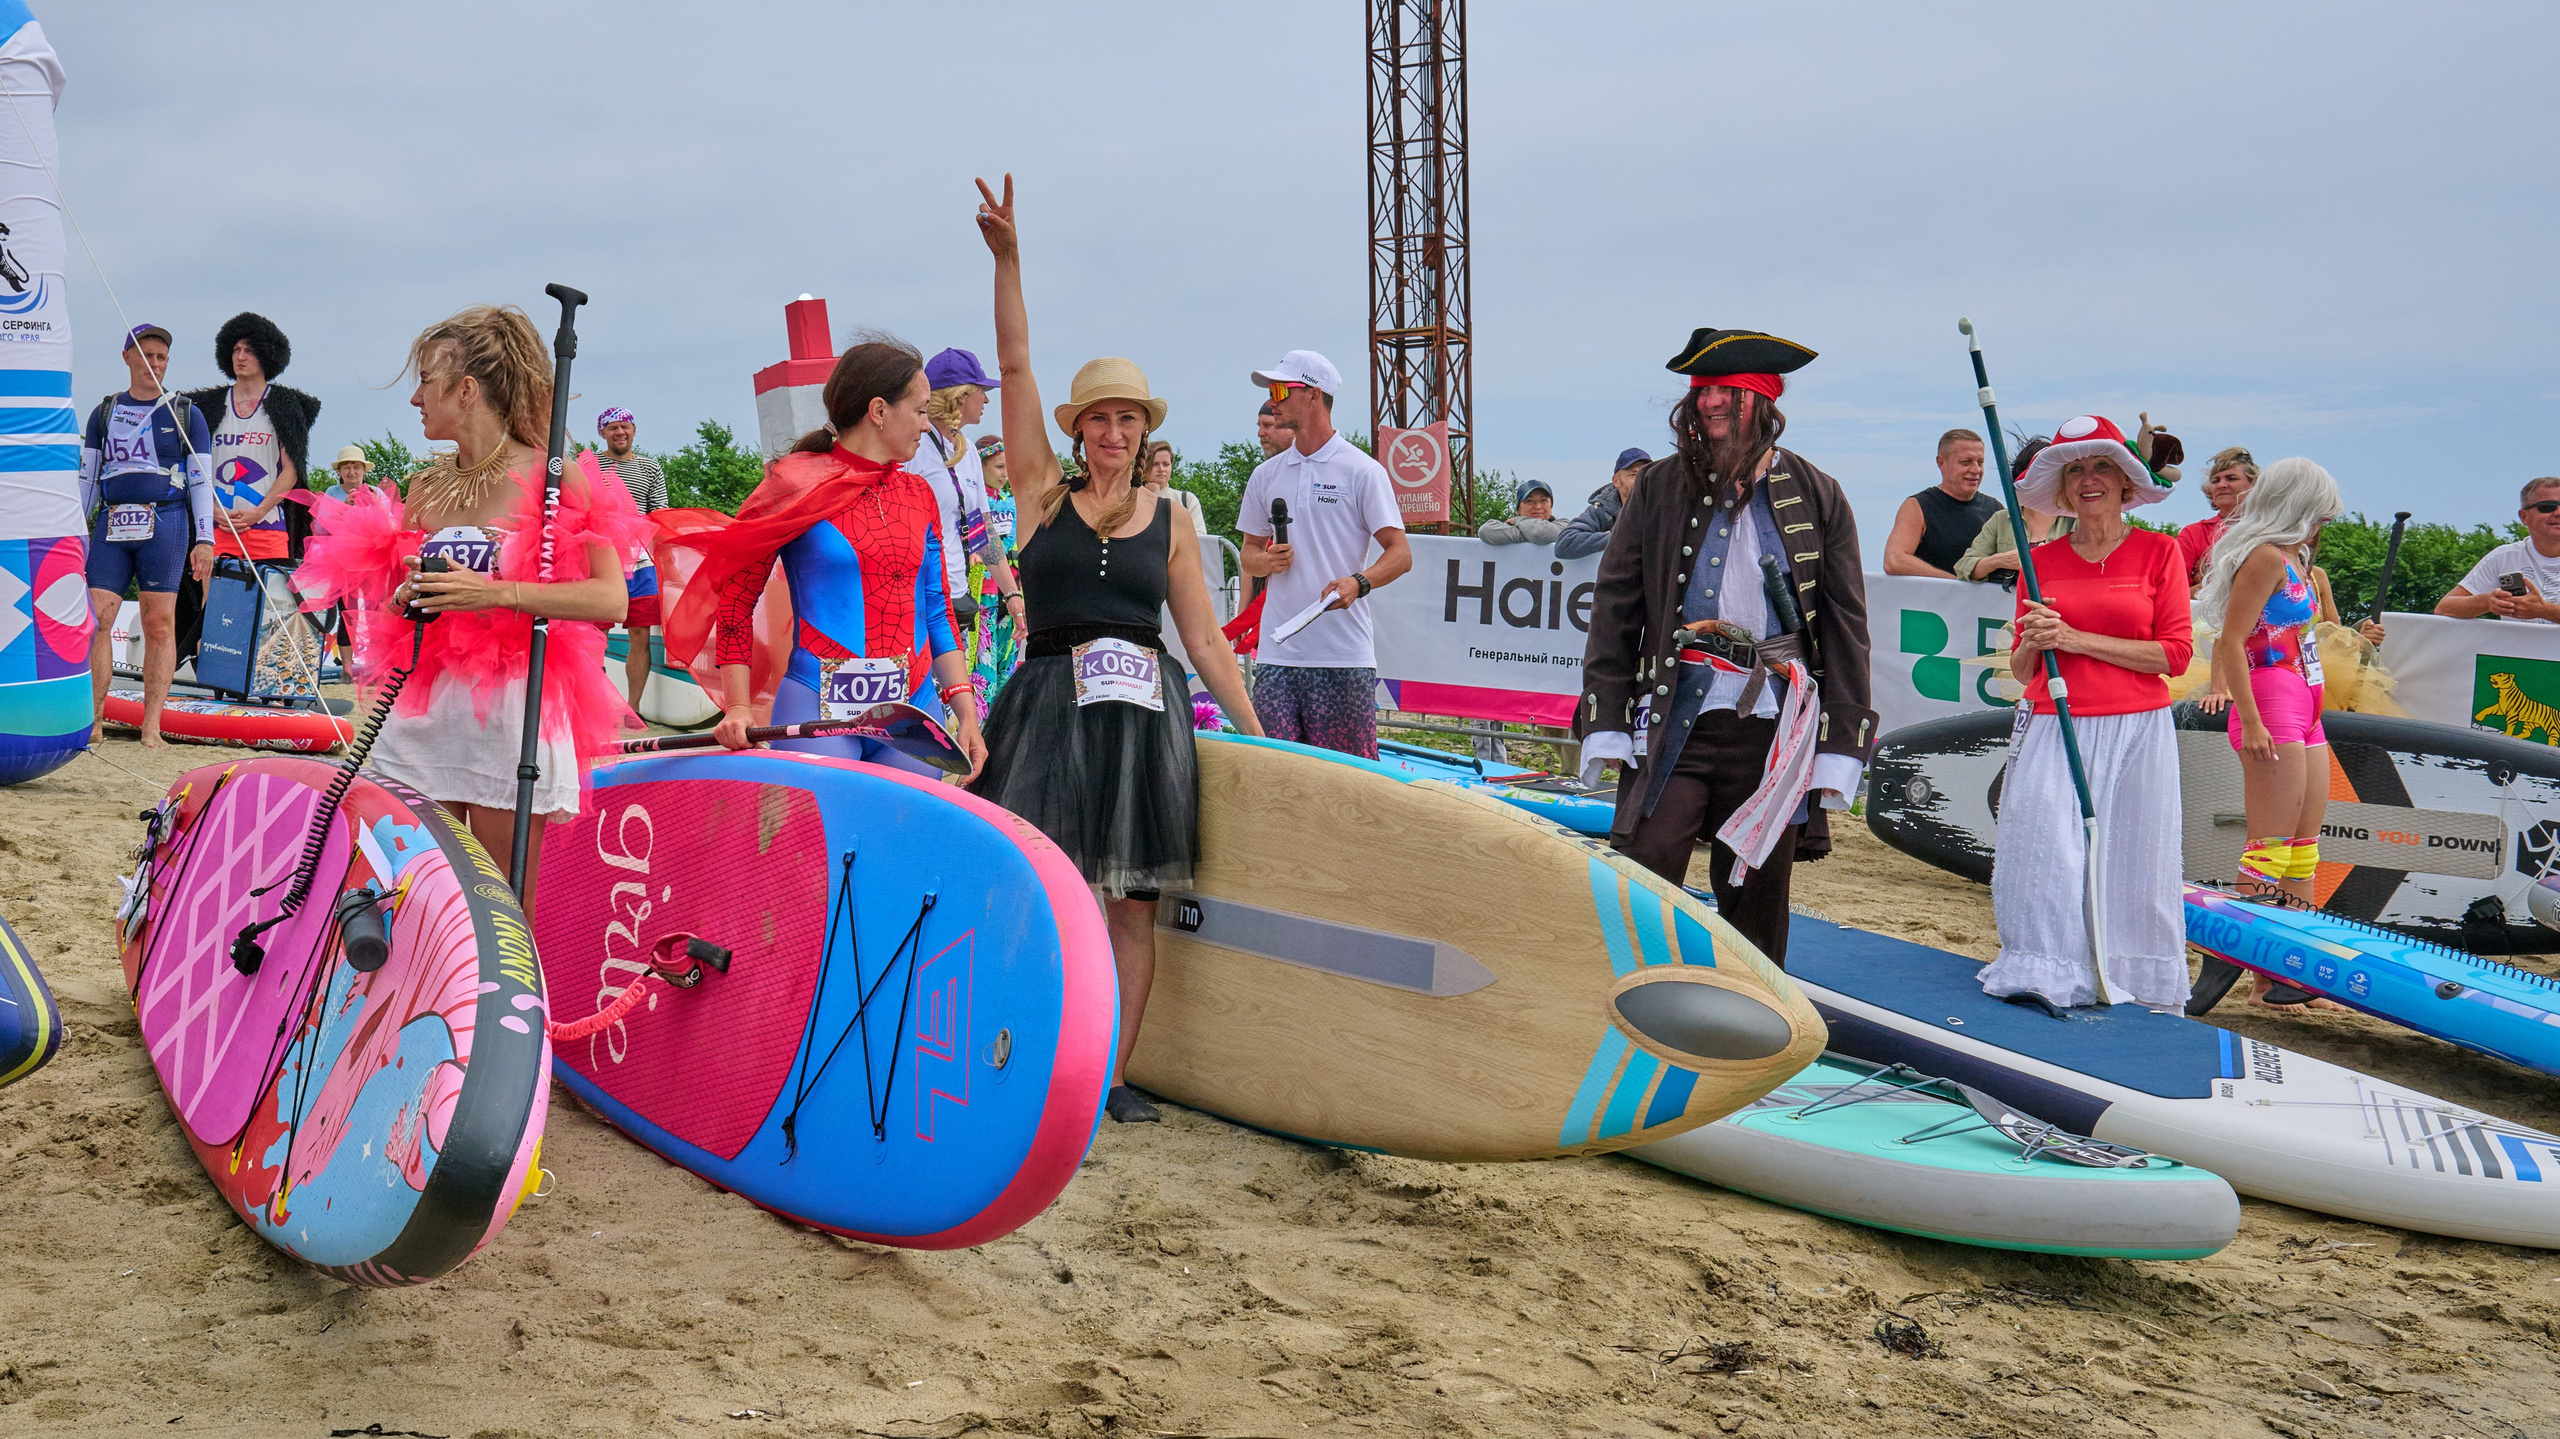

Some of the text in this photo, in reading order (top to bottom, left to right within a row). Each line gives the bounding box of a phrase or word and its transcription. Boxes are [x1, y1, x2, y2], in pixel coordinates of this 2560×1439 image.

[2, 320, 52, 332] СЕРФИНГА
[20, 333, 40, 342] КРАЯ
[1301, 372, 1319, 385] Haier
[215, 431, 273, 447] SUPFEST
[1317, 495, 1338, 505] Haier
[1396, 491, 1434, 504] КУПАНИЕ
[1398, 501, 1441, 514] ПРЕЩЕНО
[1444, 558, 1597, 633] Haie
[1469, 646, 1549, 665] Генеральный
[2319, 824, 2370, 841] RING
[2376, 829, 2421, 846] YOU
[1179, 905, 1199, 926] ULI
[490, 909, 538, 993] ANOMY
